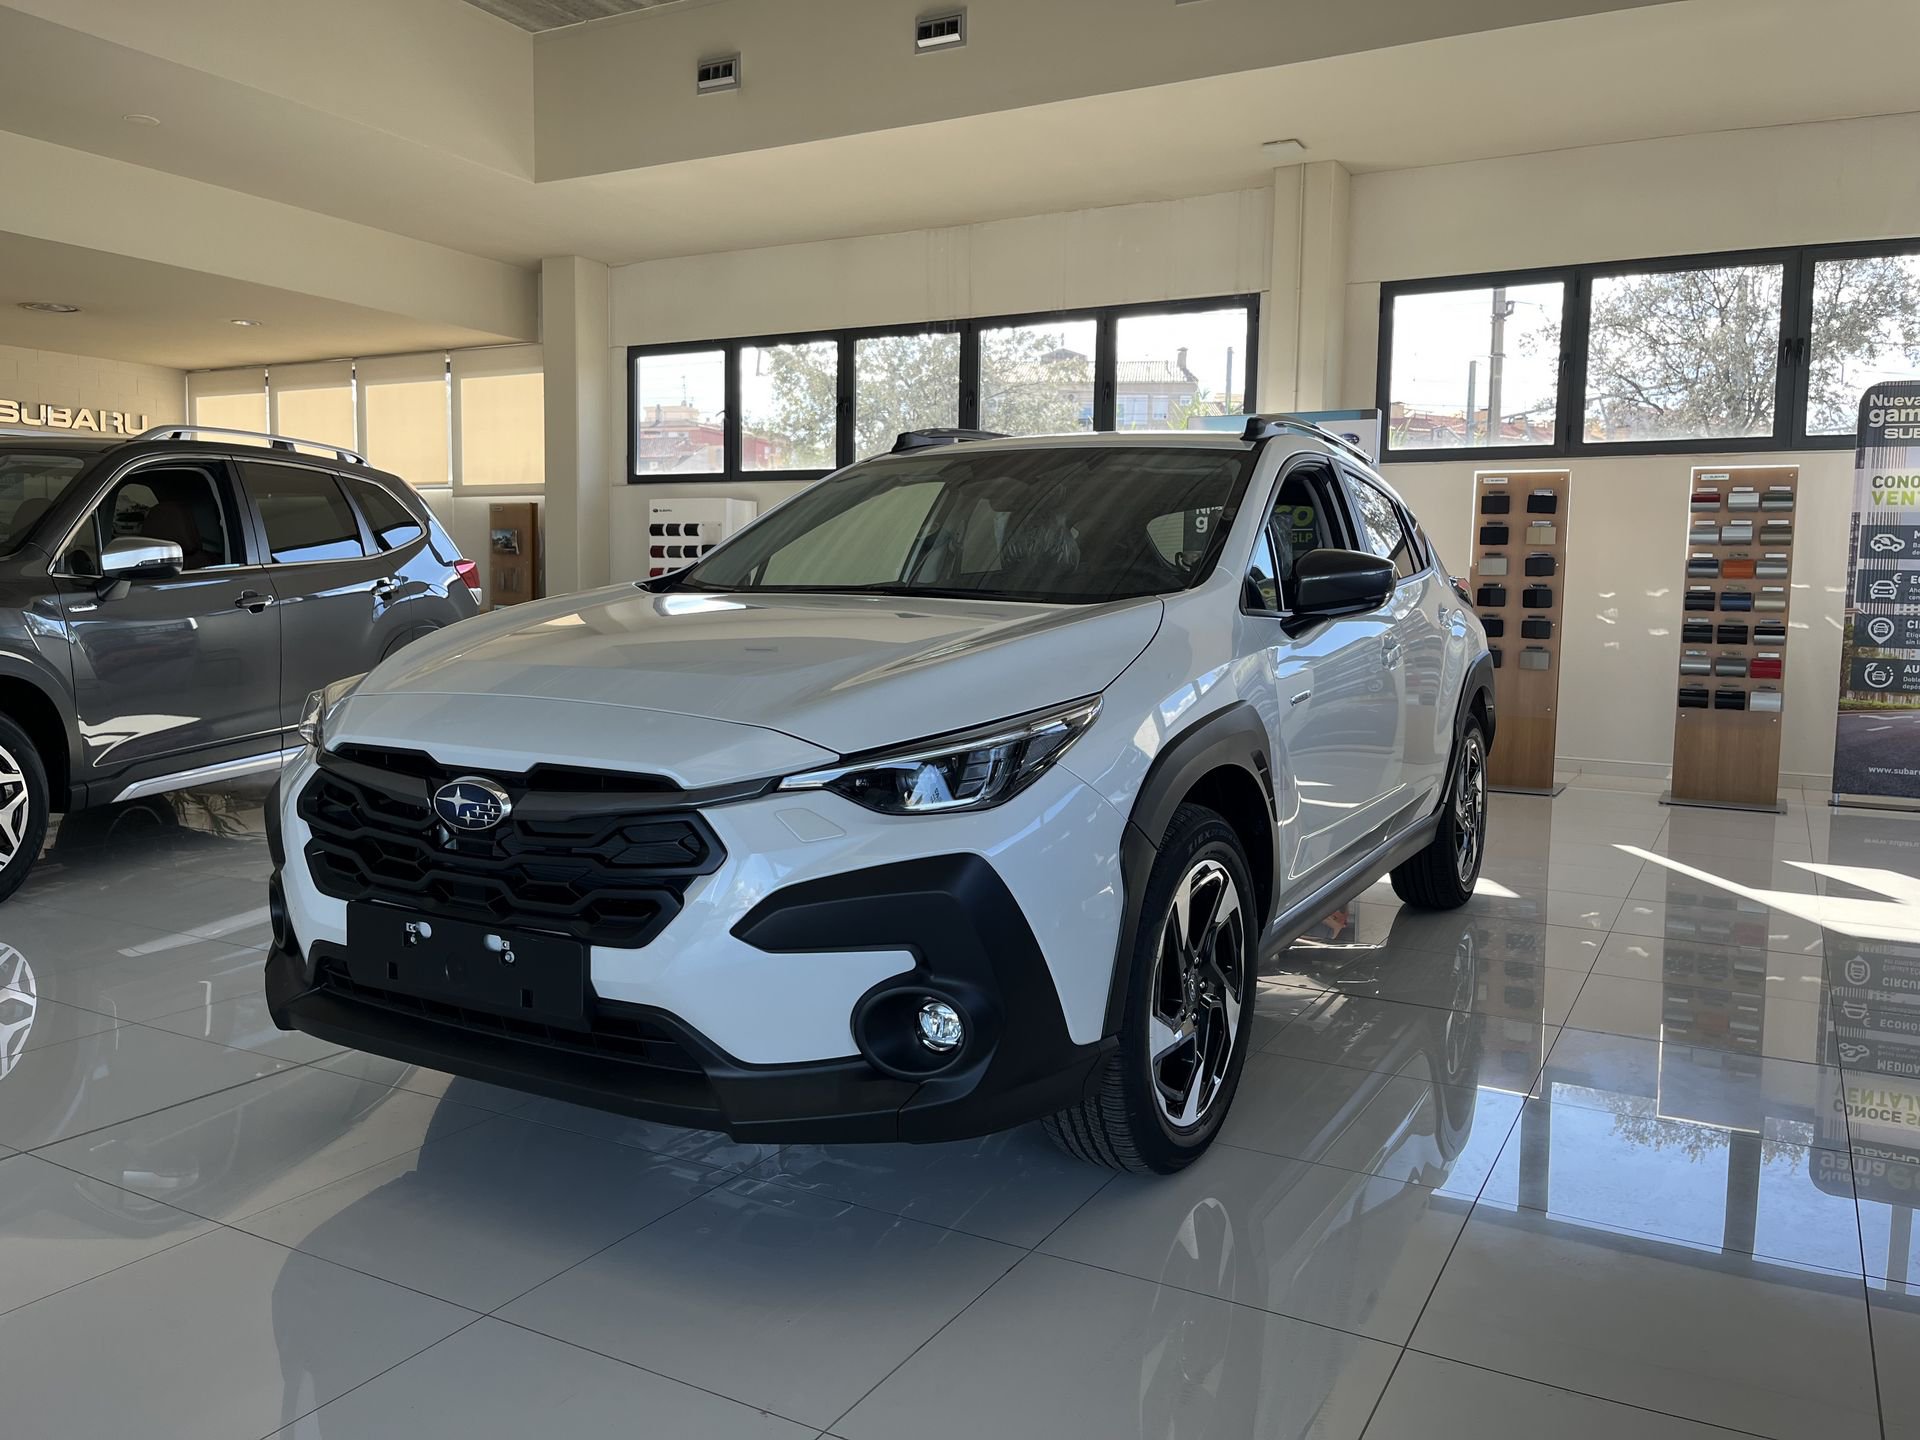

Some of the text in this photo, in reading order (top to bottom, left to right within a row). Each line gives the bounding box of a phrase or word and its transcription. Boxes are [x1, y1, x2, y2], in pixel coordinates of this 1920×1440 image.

[0, 399, 148, 435] SUBARU
[1884, 428, 1920, 439] SU
[1872, 490, 1920, 506] VEN
[1907, 620, 1920, 629] CI
[1868, 766, 1920, 776] www.subar
